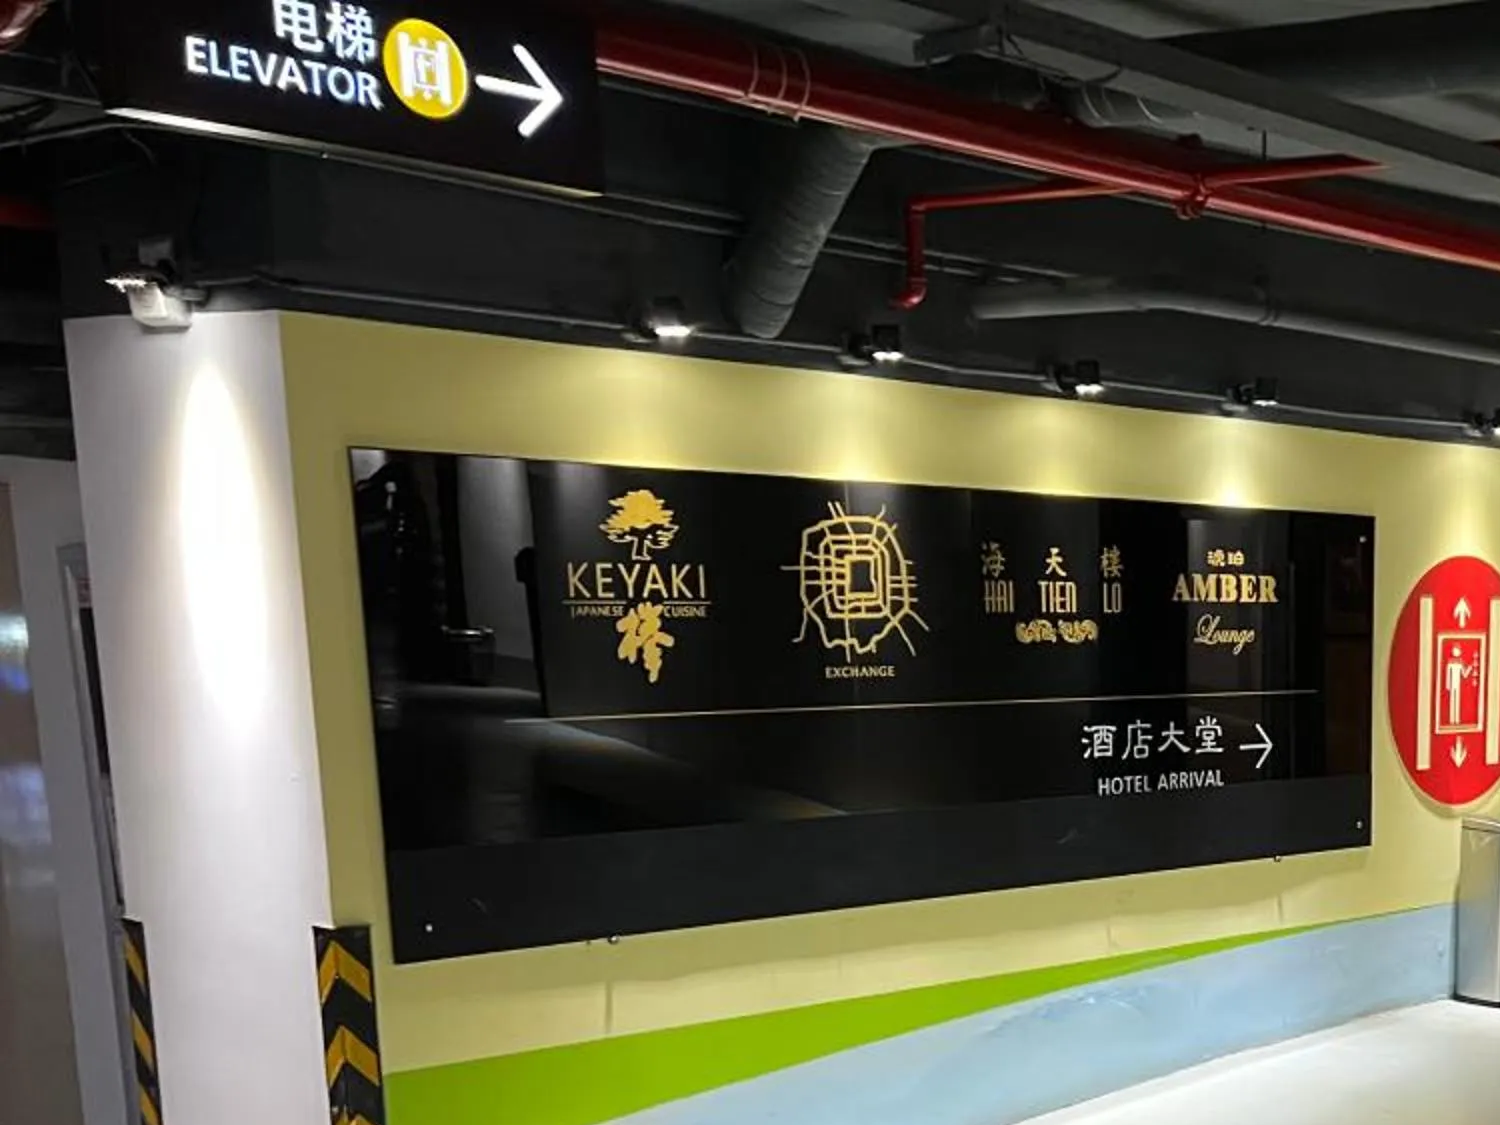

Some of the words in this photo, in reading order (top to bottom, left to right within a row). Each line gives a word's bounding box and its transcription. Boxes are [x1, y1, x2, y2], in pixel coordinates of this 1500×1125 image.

[272, 0, 379, 63] 电梯
[185, 35, 385, 110] ELEVATOR
[567, 562, 706, 599] KEYAKI
[985, 580, 1014, 613] HAI
[1038, 580, 1077, 613] TIEN
[1103, 582, 1122, 613] LO
[1172, 572, 1279, 603] AMBER
[571, 605, 624, 618] JAPANESE
[663, 605, 706, 618] CUISINE
[1193, 614, 1255, 656] Lounge
[825, 665, 896, 678] EXCHANGE
[1081, 715, 1224, 760] 酒店大堂
[1098, 775, 1151, 796] HOTEL
[1157, 769, 1225, 791] ARRIVAL
